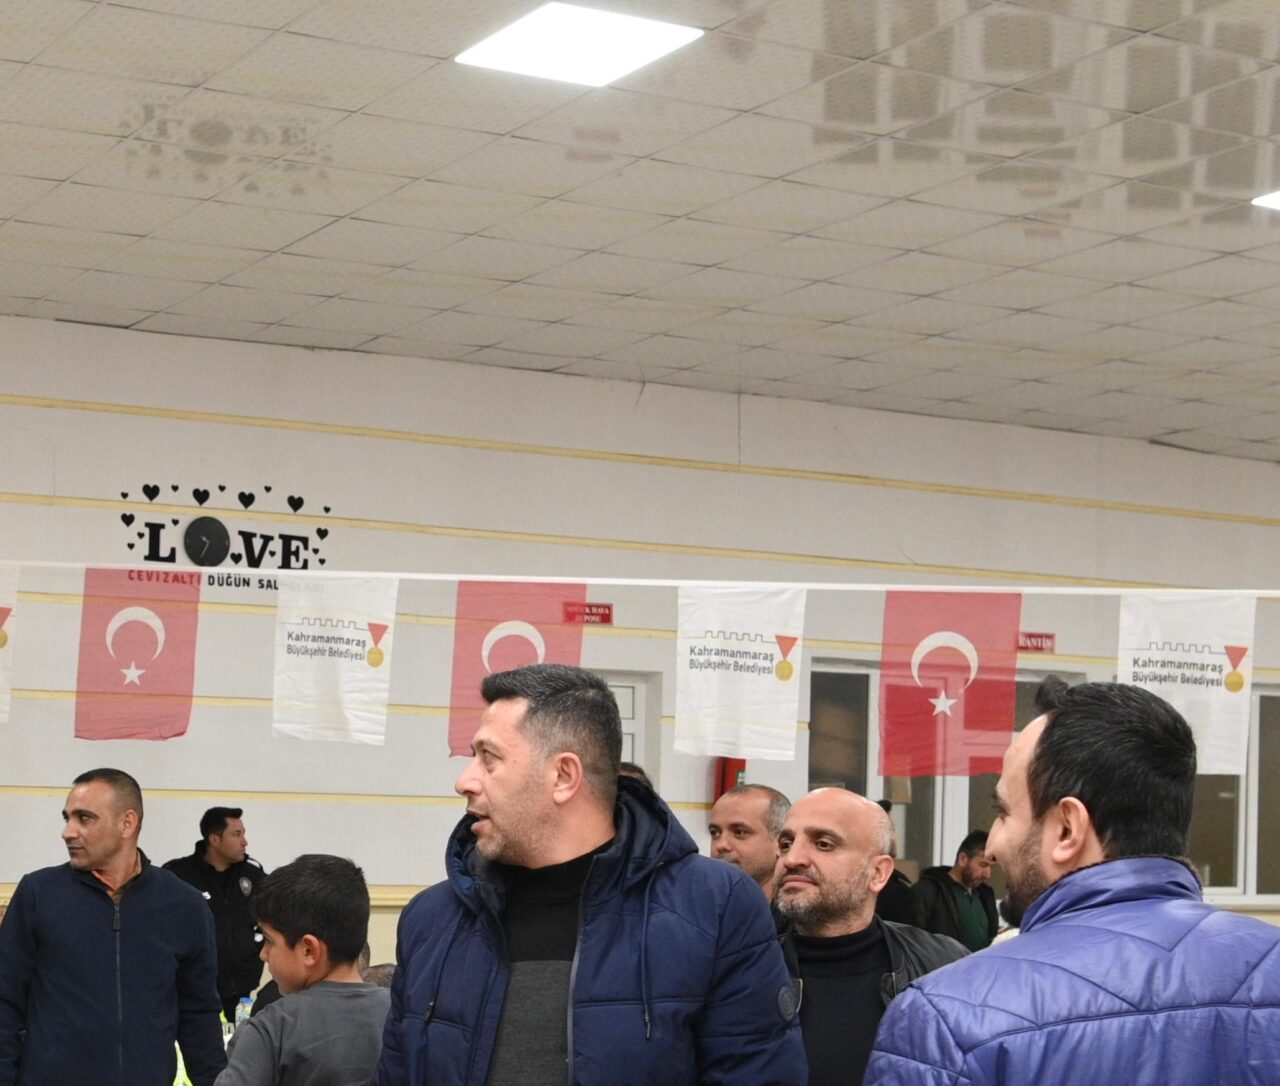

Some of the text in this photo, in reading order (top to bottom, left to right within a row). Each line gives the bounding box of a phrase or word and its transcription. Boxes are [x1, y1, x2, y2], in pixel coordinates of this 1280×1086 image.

[208, 573, 250, 588] DÜĞÜN
[287, 631, 366, 649] Kahramanmaraş
[287, 644, 366, 662] Büyükşehir Belediyesi
[689, 645, 774, 664] Kahramanmaraş
[689, 659, 774, 676] Büyükşehir Belediyesi
[1133, 657, 1224, 675] Kahramanmaraş
[1132, 671, 1222, 687] Büyükşehir Belediyesi
